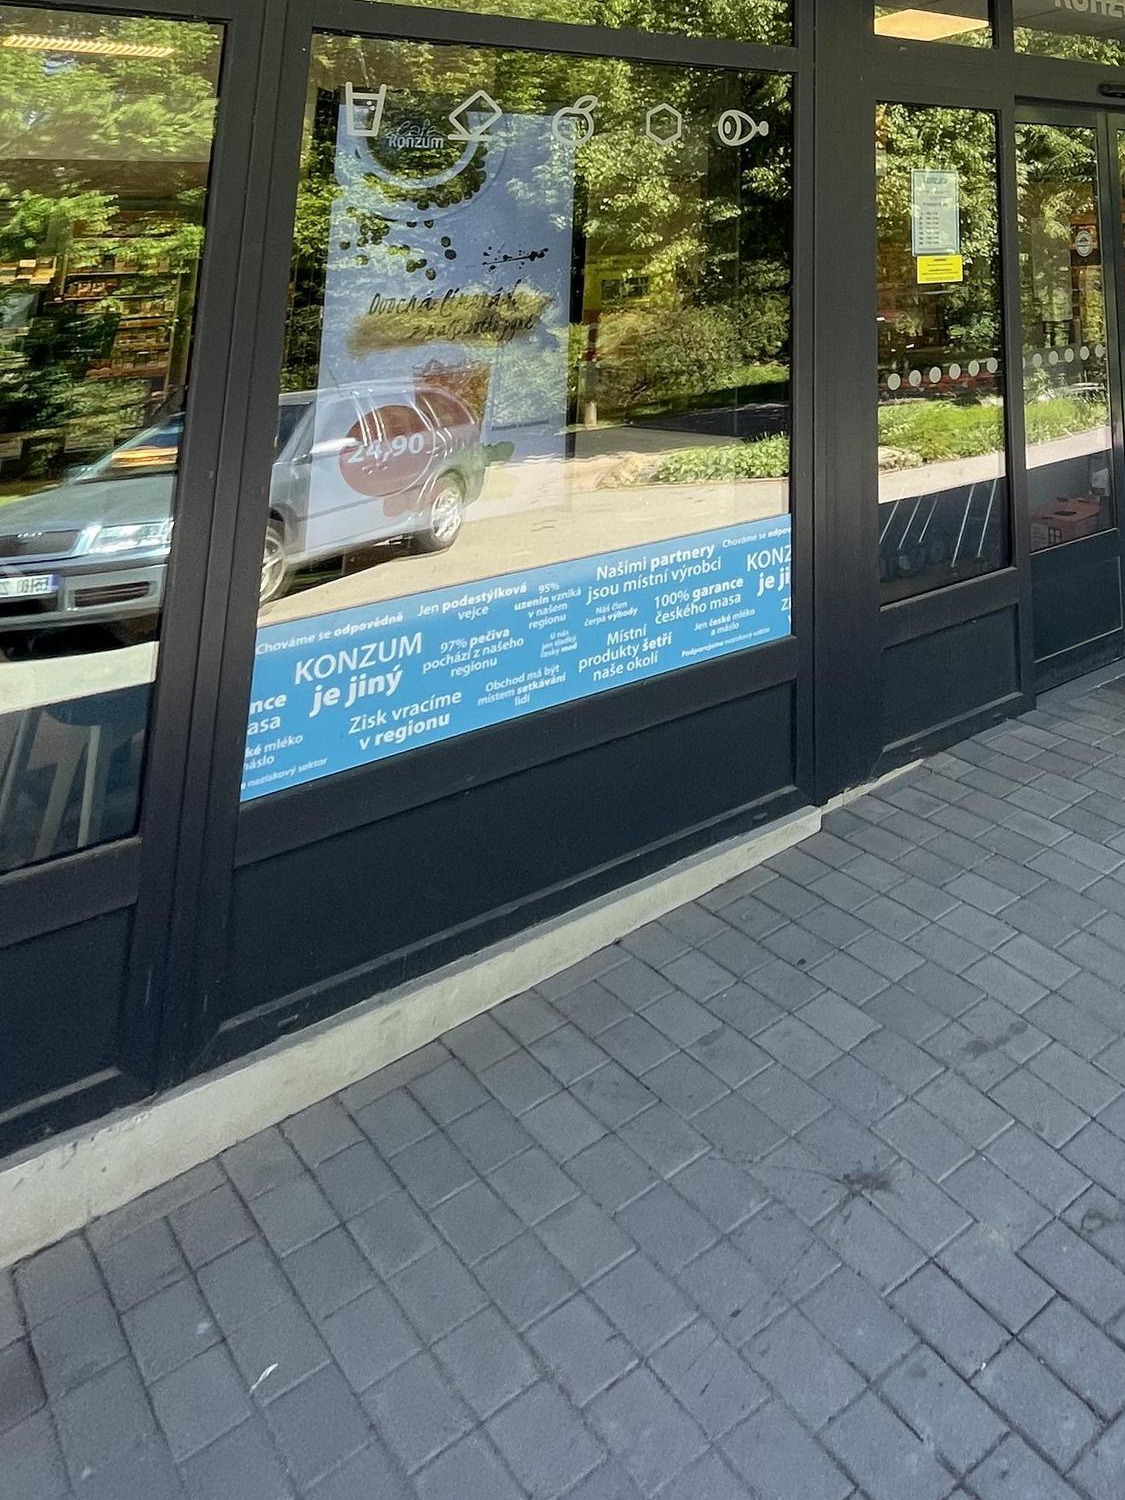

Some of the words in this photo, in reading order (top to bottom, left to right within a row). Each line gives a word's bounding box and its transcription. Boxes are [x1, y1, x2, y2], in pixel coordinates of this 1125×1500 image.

[596, 557, 647, 581] Našimi
[650, 544, 715, 573] partnery
[538, 582, 560, 594] 95%
[586, 583, 619, 605] jsou
[623, 567, 668, 593] místní
[671, 556, 722, 583] výrobci
[654, 589, 690, 609] 100%
[692, 576, 744, 601] garance
[757, 572, 775, 597] je
[417, 603, 440, 617] Jen
[442, 583, 527, 613] podestýlková
[457, 605, 490, 621] vejce
[514, 595, 549, 611] uzenin
[537, 601, 568, 617] našem
[655, 601, 707, 625] českého
[709, 593, 742, 610] masa
[255, 633, 316, 655] Chováme
[318, 630, 331, 642] se
[334, 612, 404, 637] odpovědně
[528, 614, 566, 630] regionu
[606, 624, 647, 646] Místní
[422, 649, 471, 675] pochází
[482, 635, 525, 657] našeho
[440, 638, 468, 653] 97%
[469, 627, 511, 652] pečiva
[578, 643, 640, 673] produkty
[641, 632, 673, 652] šetří
[295, 632, 422, 685] KONZUM
[450, 656, 498, 678] regionu
[593, 664, 624, 682] naše
[626, 651, 658, 672] okolí
[308, 684, 341, 718] je
[344, 664, 404, 708] jiný
[477, 688, 515, 706] místem
[517, 674, 566, 695] setkávání
[485, 671, 525, 693] Obchod
[527, 668, 542, 681] má
[544, 664, 560, 678] být
[348, 709, 388, 734] Zisk
[391, 690, 462, 721] vracíme
[514, 694, 531, 706] lidí
[264, 734, 304, 753] mléko
[359, 736, 371, 750] v
[374, 712, 450, 745] regionu
